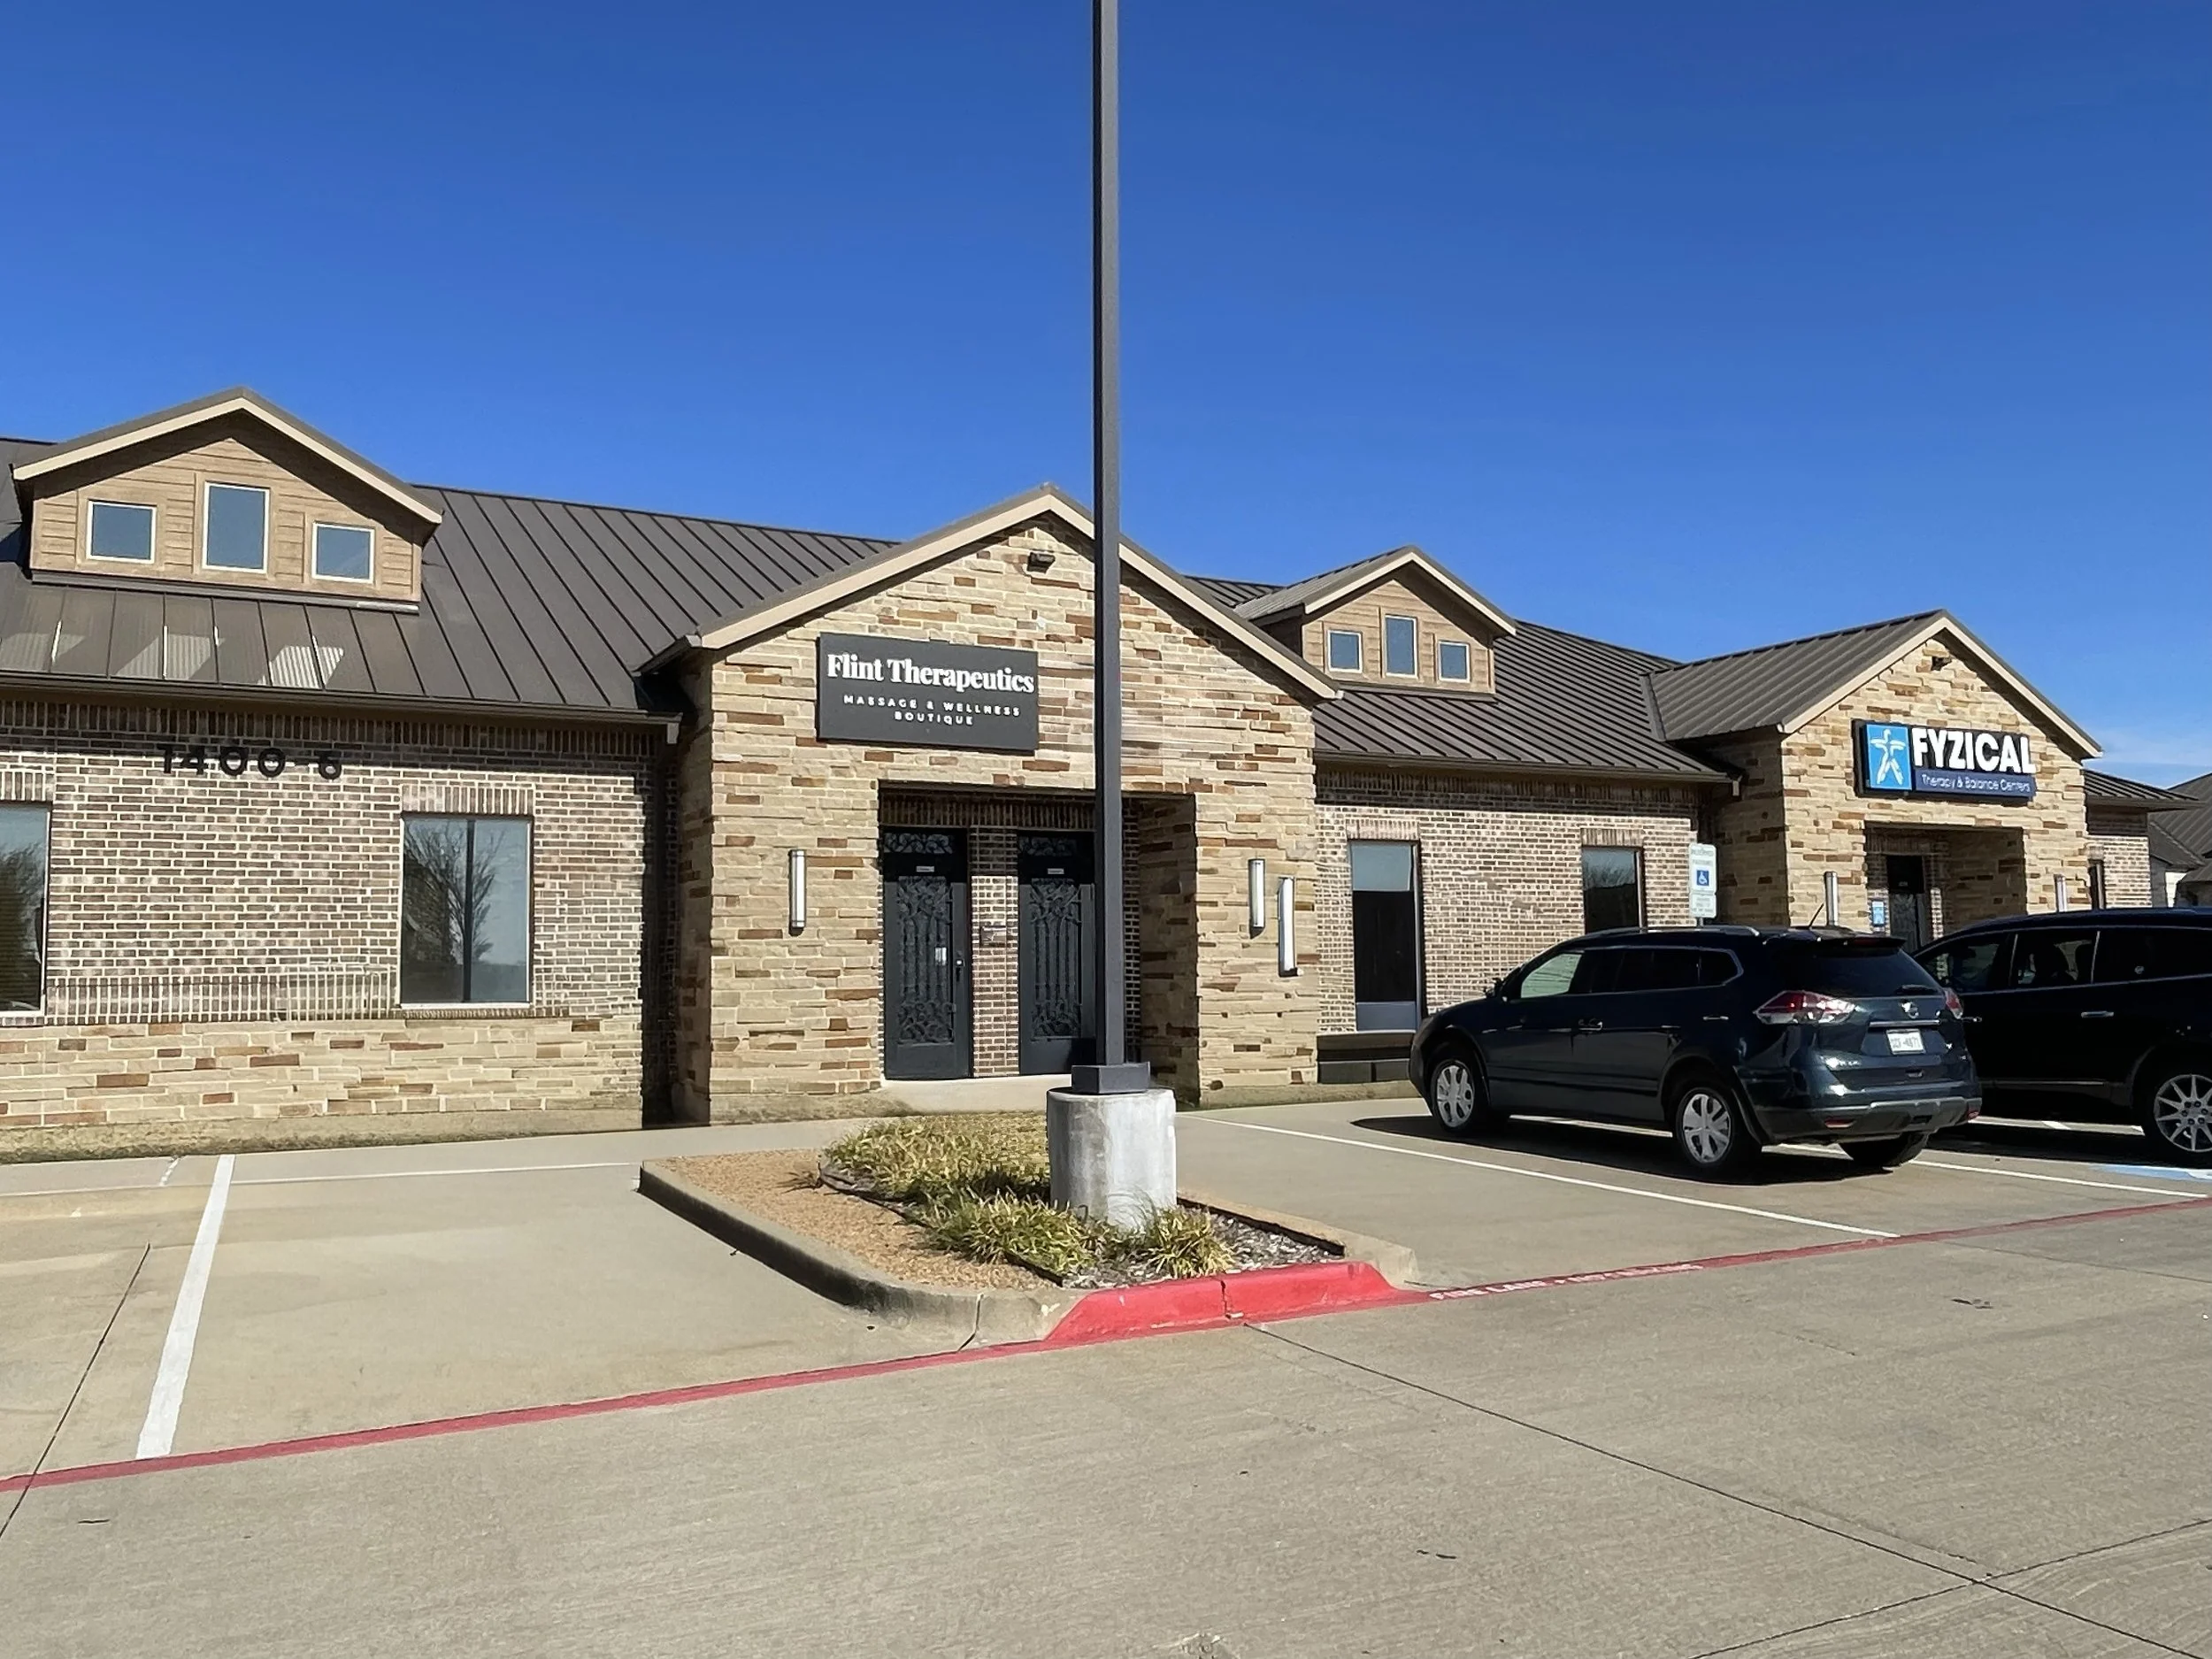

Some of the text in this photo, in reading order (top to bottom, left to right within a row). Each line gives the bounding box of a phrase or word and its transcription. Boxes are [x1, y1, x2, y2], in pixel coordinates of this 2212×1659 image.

[827, 651, 1034, 694] Flint Therapeutics
[843, 695, 1020, 717] MASSAGE & WELLNESS
[894, 710, 973, 726] BOUTIQUE
[1911, 727, 2036, 774] FYZICAL
